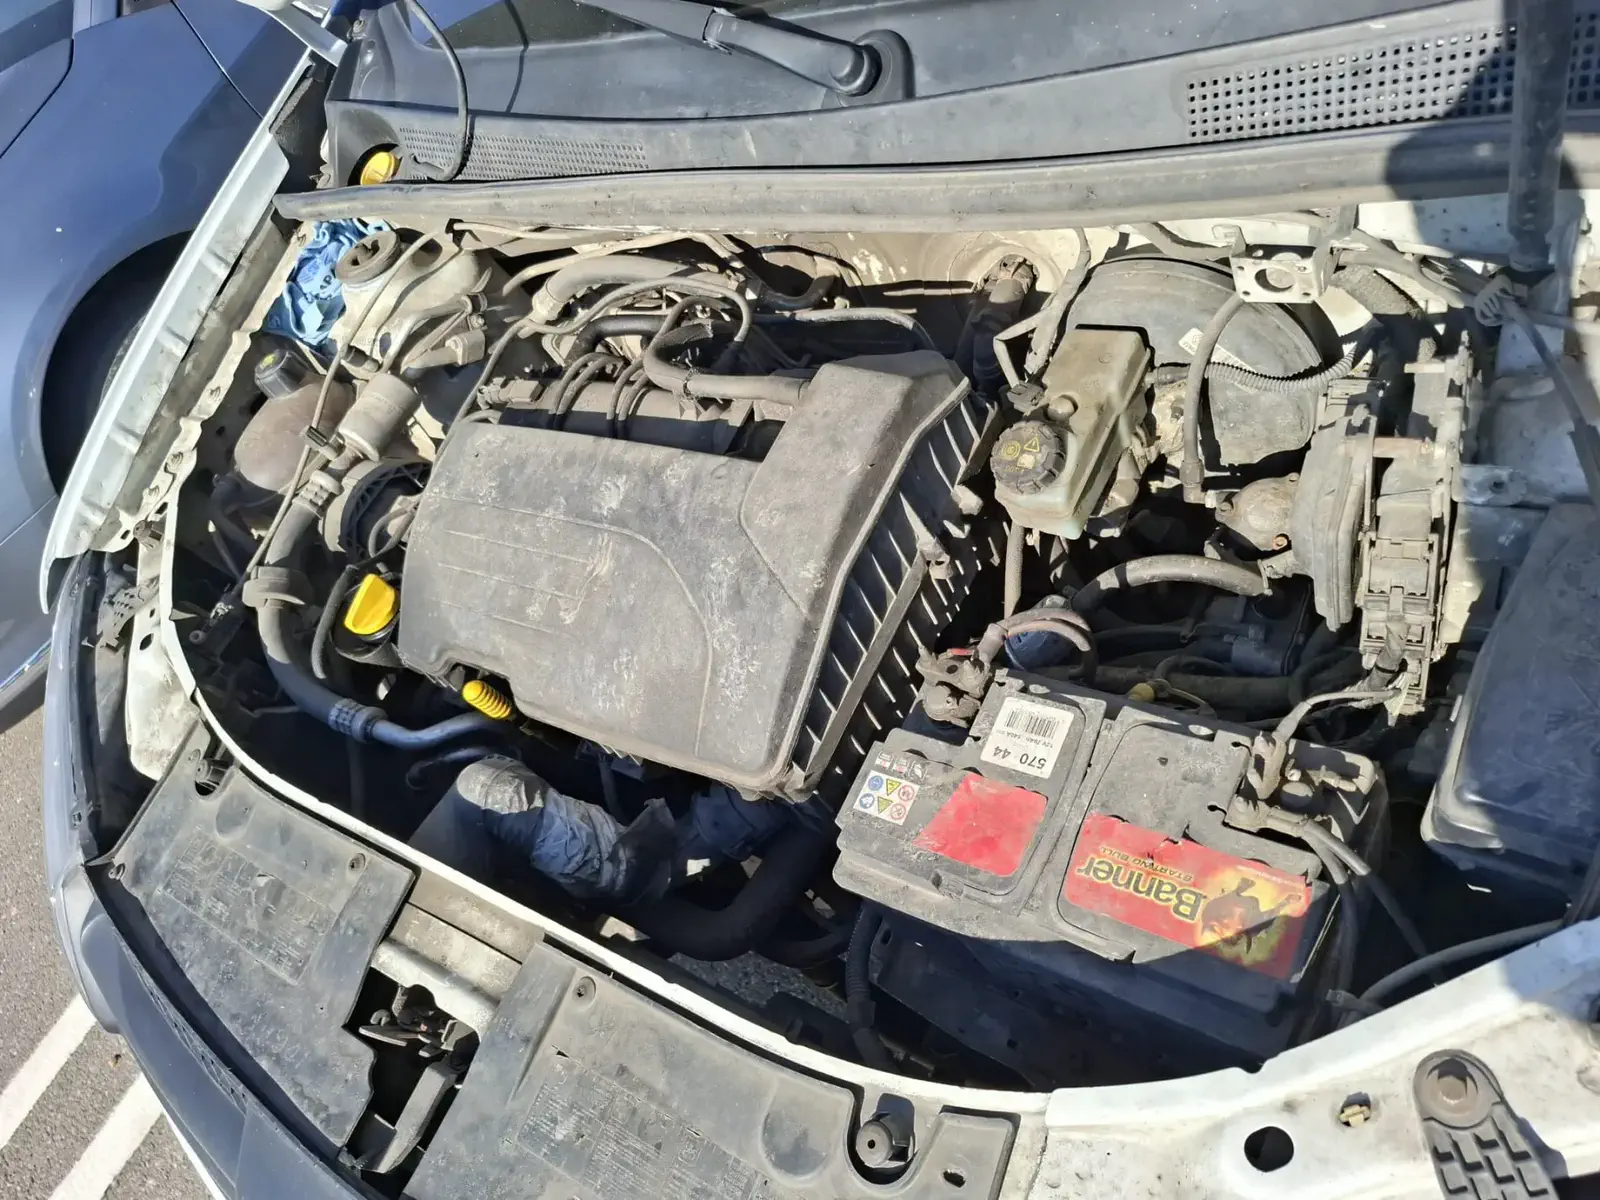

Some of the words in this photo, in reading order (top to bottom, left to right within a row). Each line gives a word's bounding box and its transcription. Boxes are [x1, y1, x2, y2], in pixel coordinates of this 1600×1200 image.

[993, 746, 1011, 759] 44
[1020, 753, 1047, 769] 570
[1101, 846, 1129, 861] BULL
[1077, 856, 1206, 922] Banner
